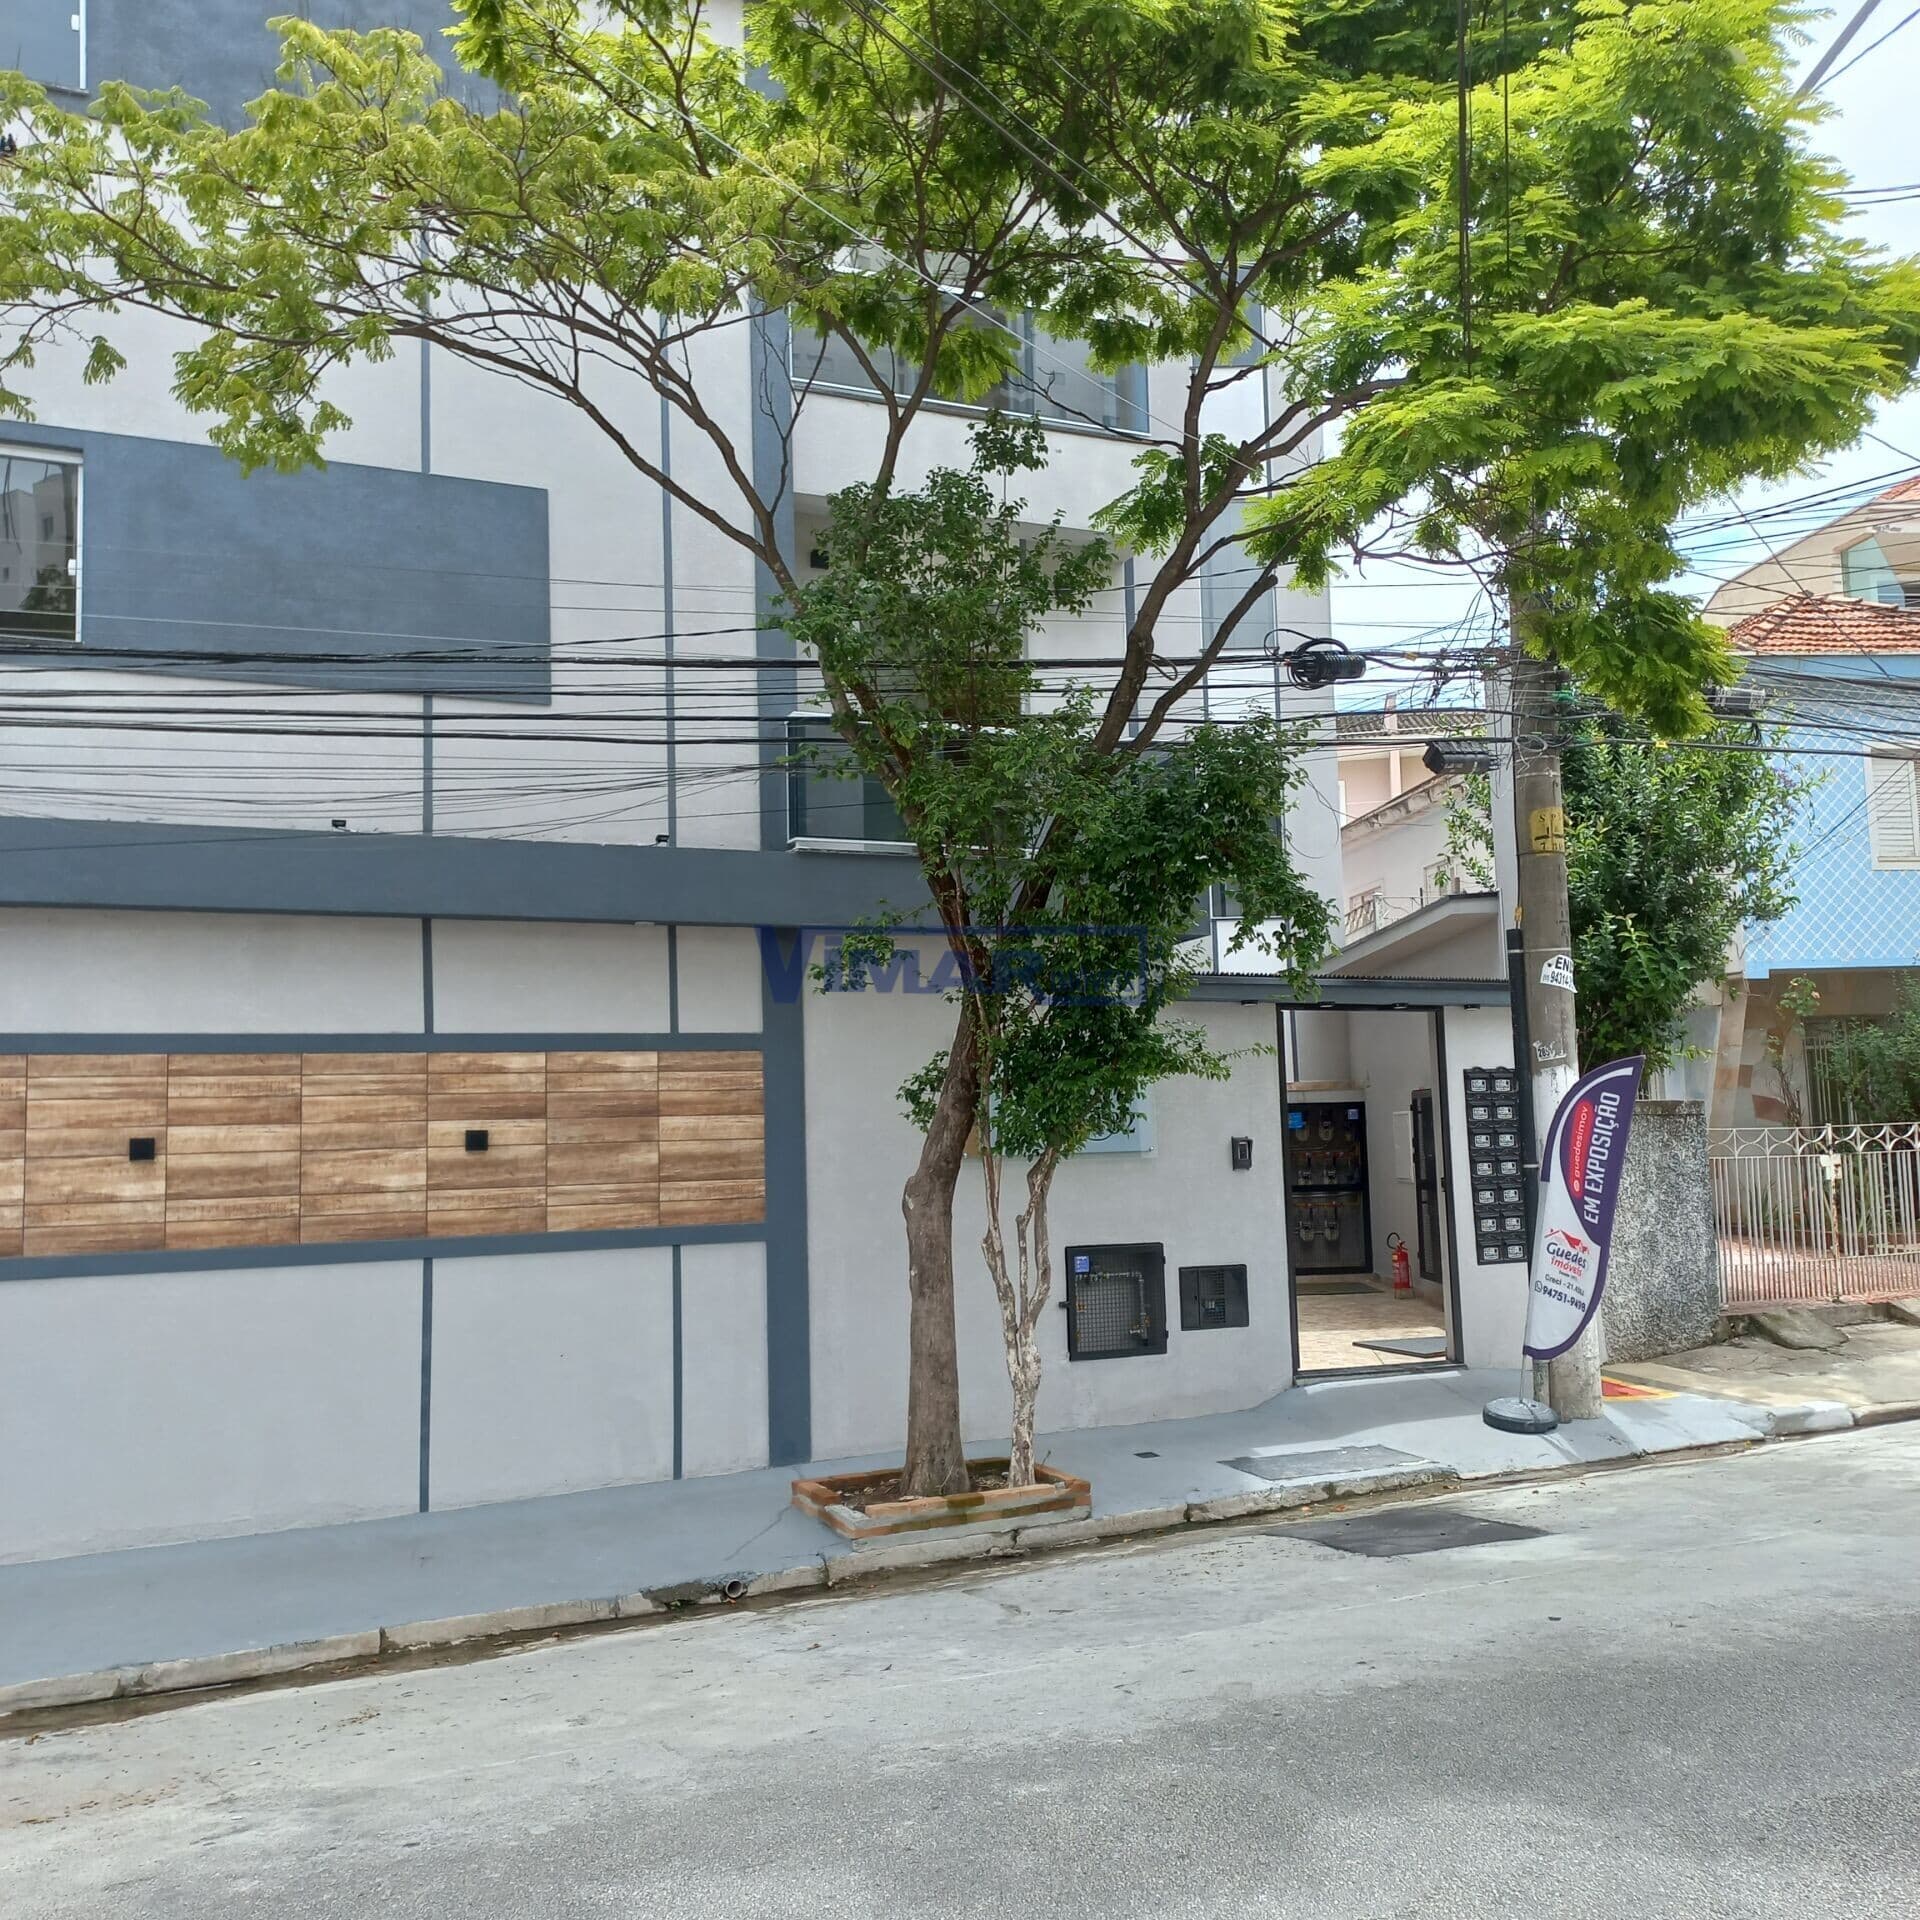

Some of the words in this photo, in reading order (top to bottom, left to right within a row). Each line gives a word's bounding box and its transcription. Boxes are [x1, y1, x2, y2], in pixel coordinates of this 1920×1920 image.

[1584, 1091, 1620, 1194] EXPOSIÇÃO
[1583, 1195, 1600, 1224] EM
[1546, 1242, 1588, 1269] Guedes
